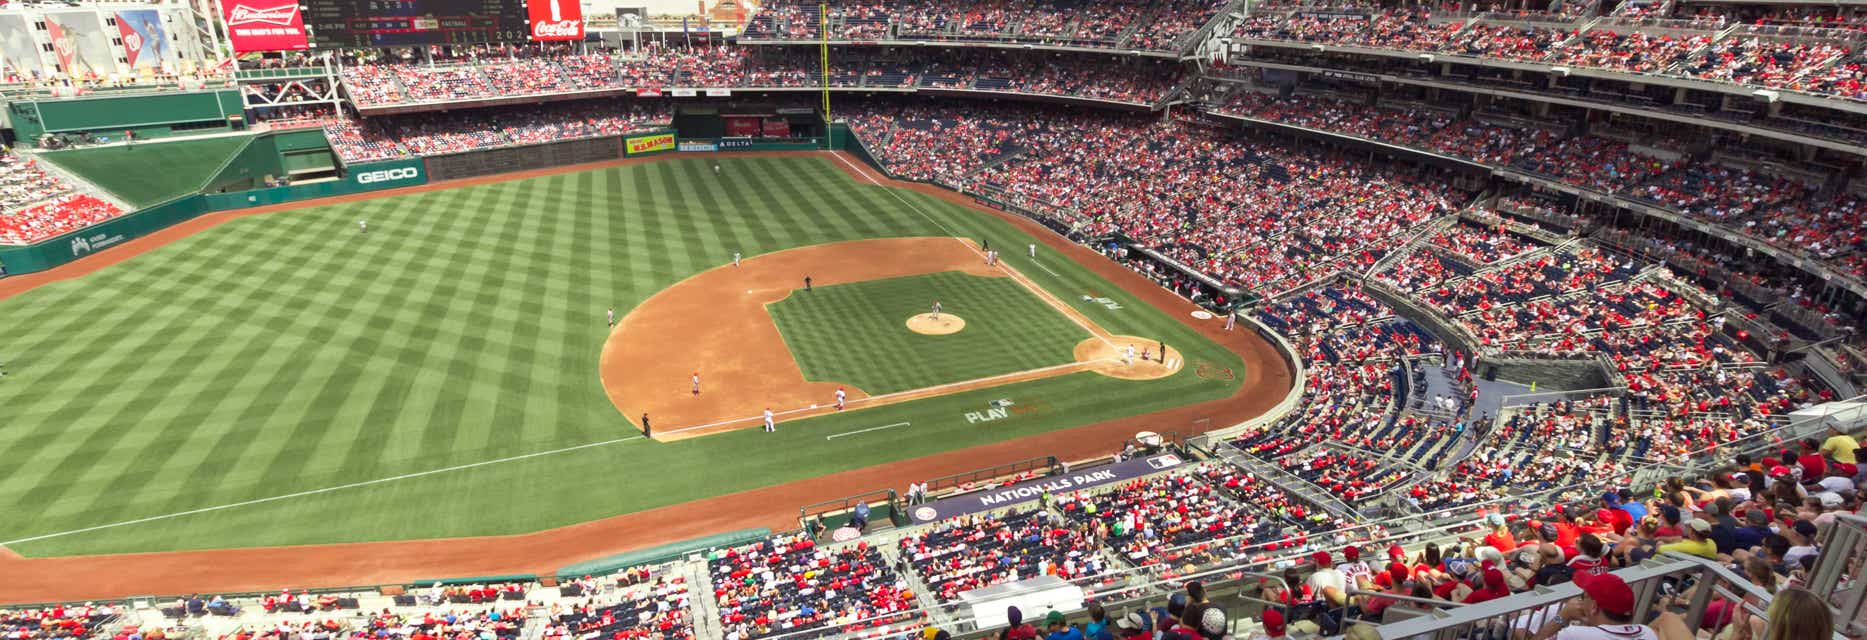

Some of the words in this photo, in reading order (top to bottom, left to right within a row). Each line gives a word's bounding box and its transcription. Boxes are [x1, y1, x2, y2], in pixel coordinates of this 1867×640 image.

[535, 20, 580, 37] Coca-Cola
[357, 167, 418, 184] GEICO
[964, 407, 1008, 424] PLAY
[1073, 469, 1116, 485] PARK
